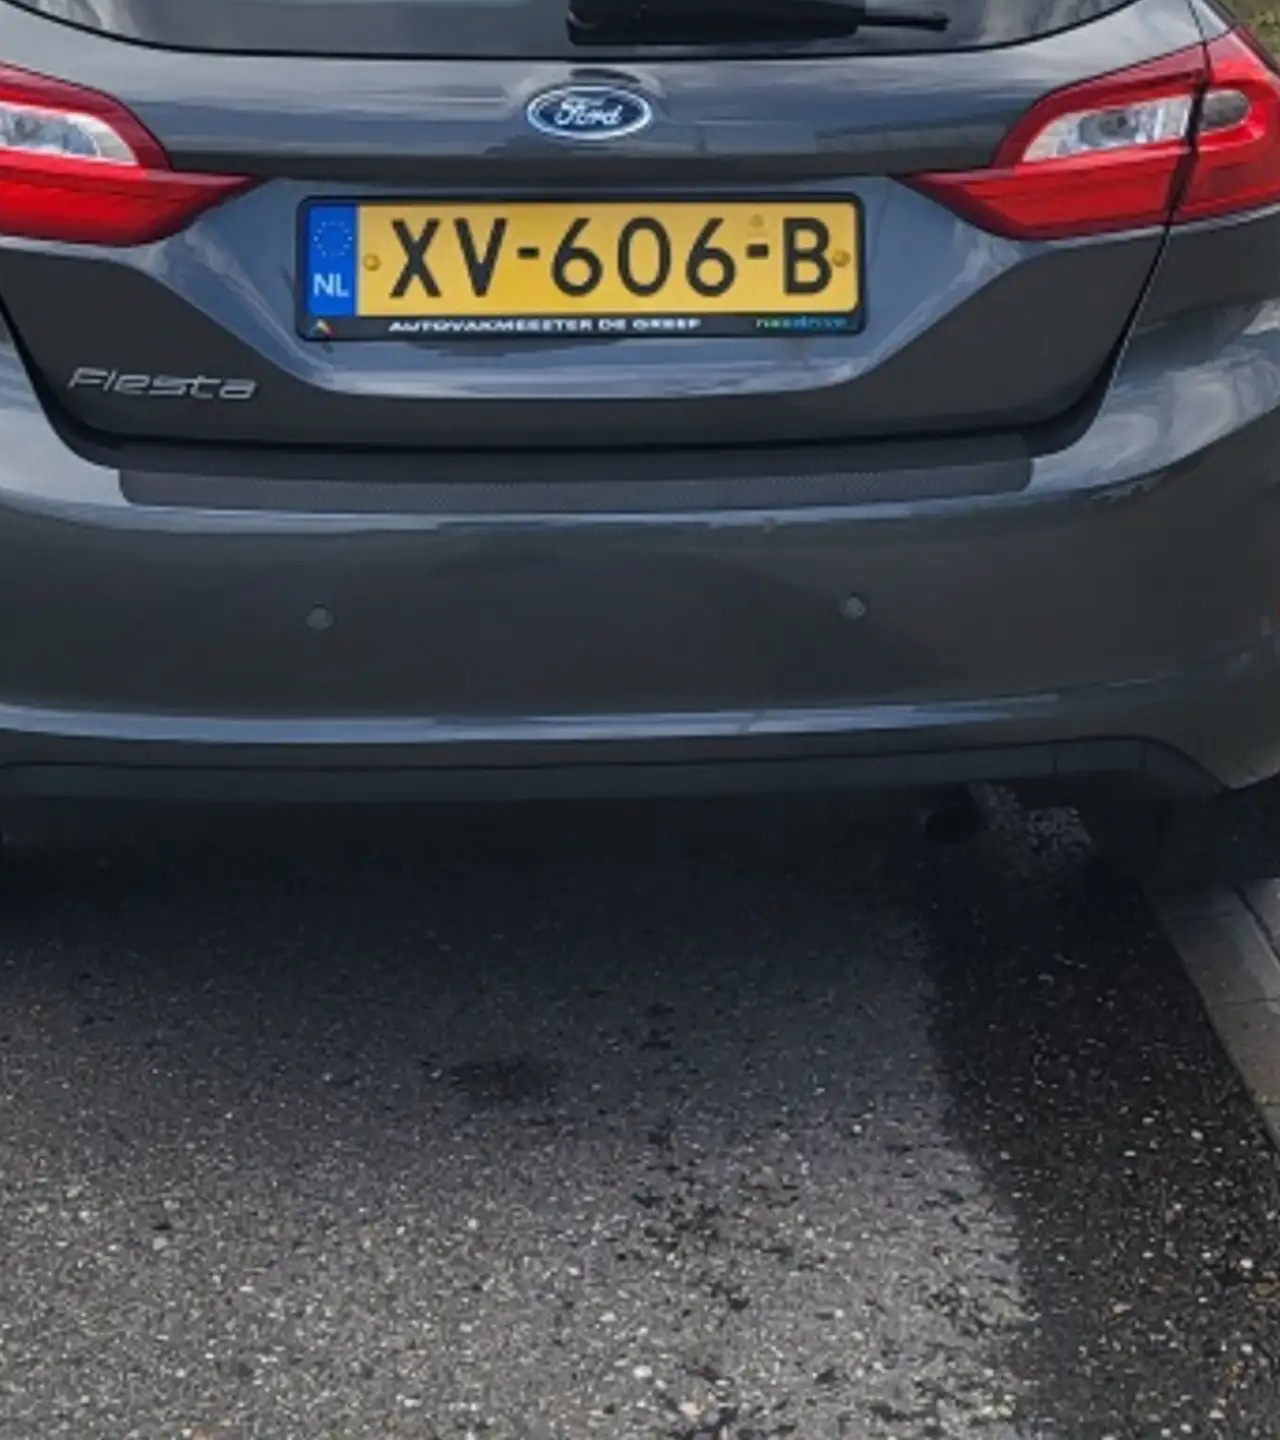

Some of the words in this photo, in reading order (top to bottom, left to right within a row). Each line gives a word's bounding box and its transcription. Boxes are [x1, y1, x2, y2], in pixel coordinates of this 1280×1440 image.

[554, 97, 624, 126] Ford
[313, 272, 350, 298] NL
[389, 216, 833, 298] XV-606-B
[388, 317, 594, 333] AUTOVAKMEESTER
[597, 317, 627, 331] DE
[631, 317, 702, 331] GREEF
[68, 366, 258, 400] Fiesta
